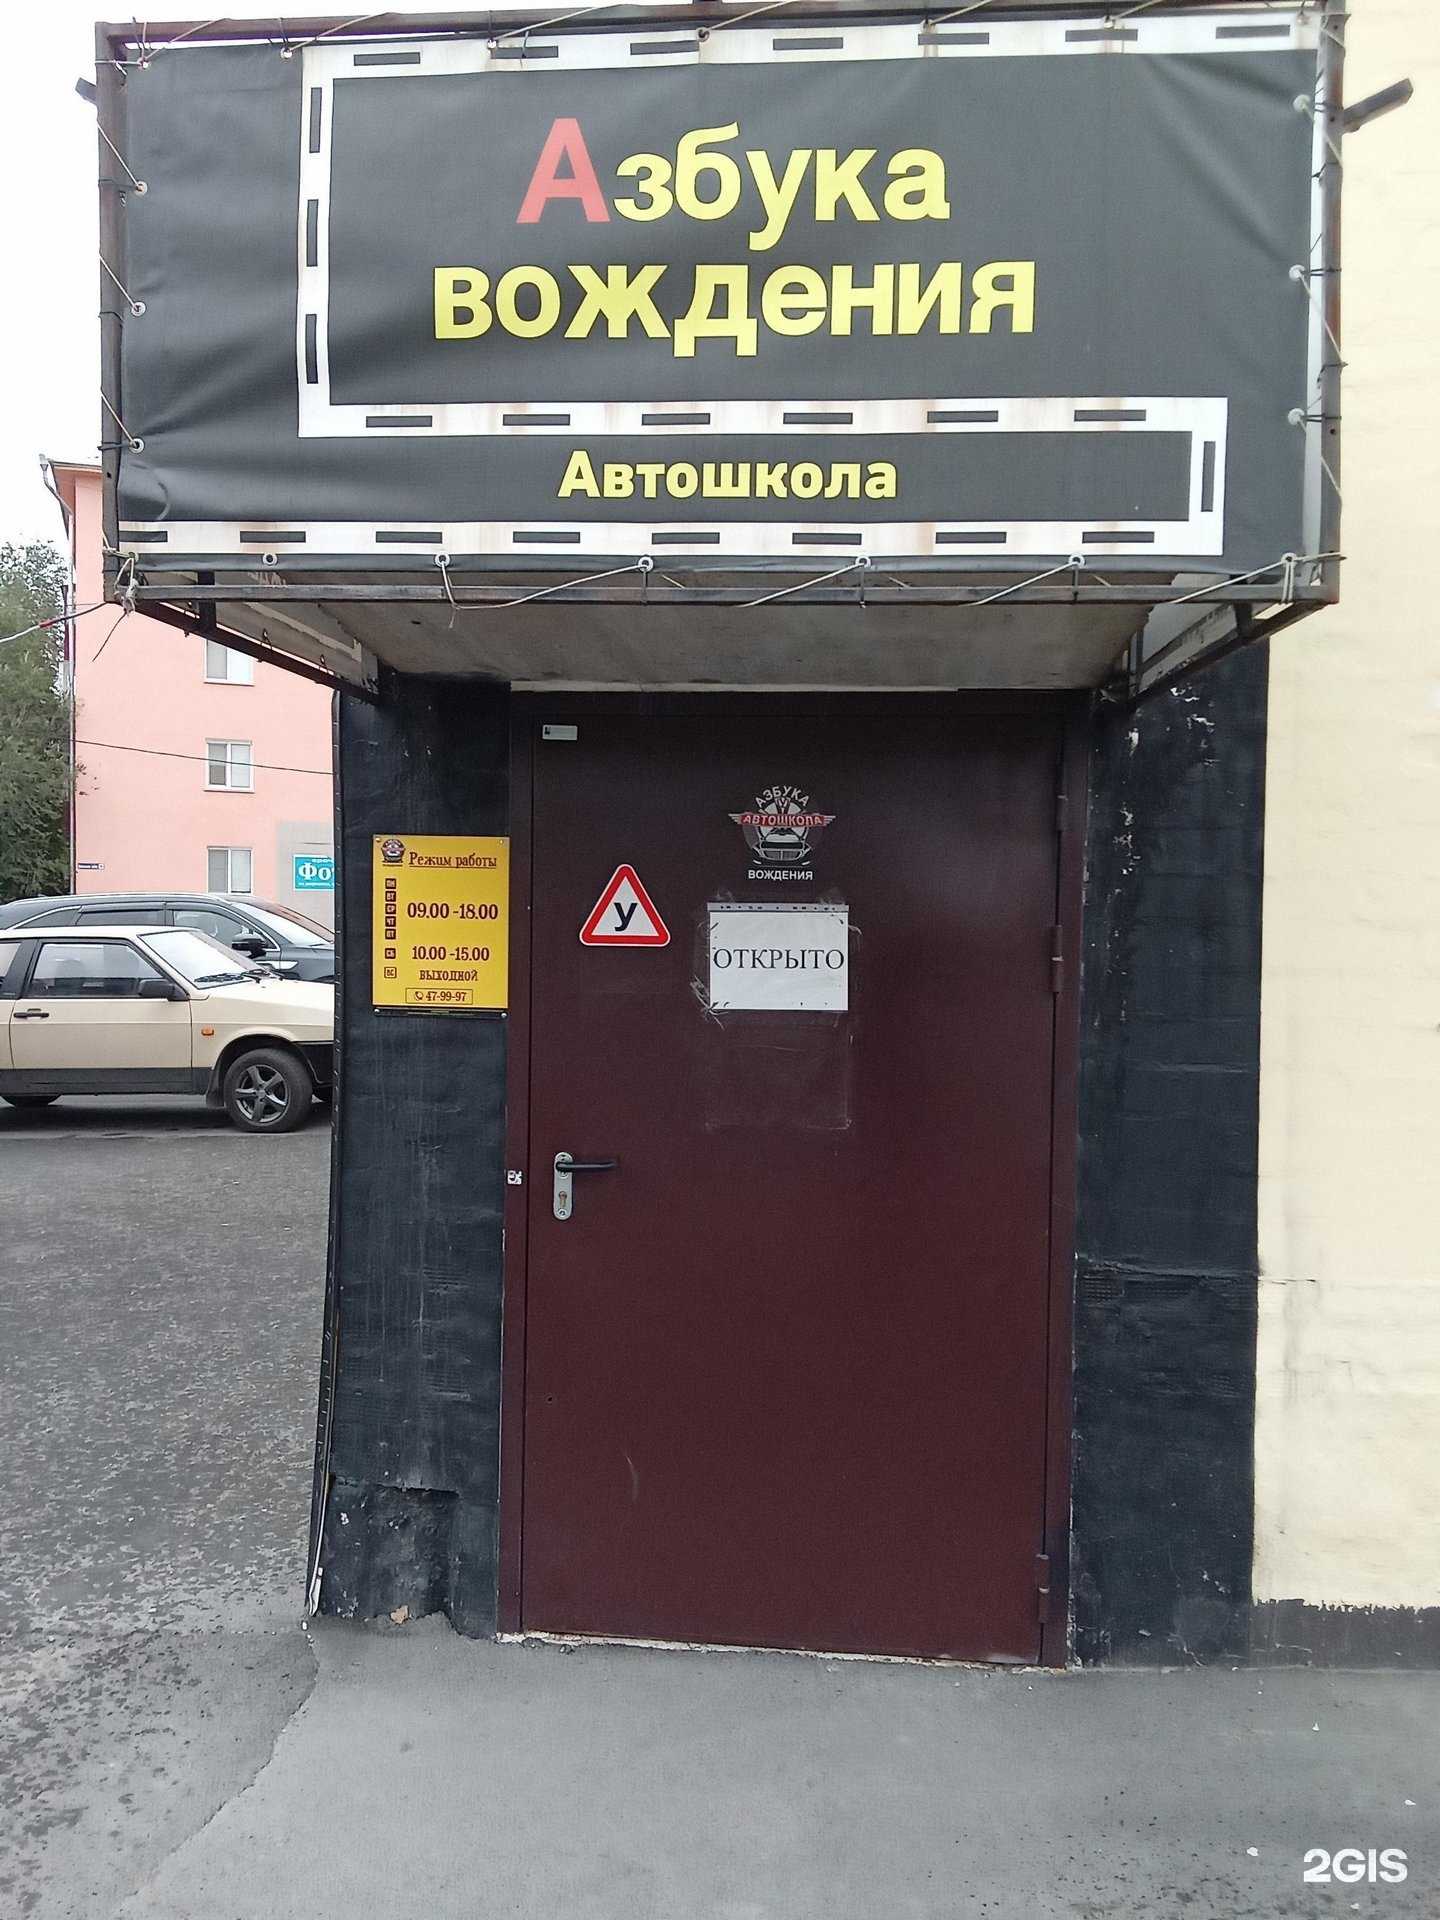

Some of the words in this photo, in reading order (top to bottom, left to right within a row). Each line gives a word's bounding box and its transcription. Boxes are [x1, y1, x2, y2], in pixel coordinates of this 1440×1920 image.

[515, 117, 951, 252] Азбука
[433, 260, 1036, 359] вождения
[557, 449, 898, 500] Автошкола
[755, 785, 810, 808] АЗБУКА
[742, 814, 823, 826] АВТОШКОЛА
[408, 851, 451, 866] Режим
[455, 852, 498, 869] работы
[298, 862, 335, 881] Фо
[748, 869, 814, 881] ВОЖДЕНИЯ
[713, 949, 845, 970] ОТКРЫТО
[425, 991, 467, 1002] 47-99-97
